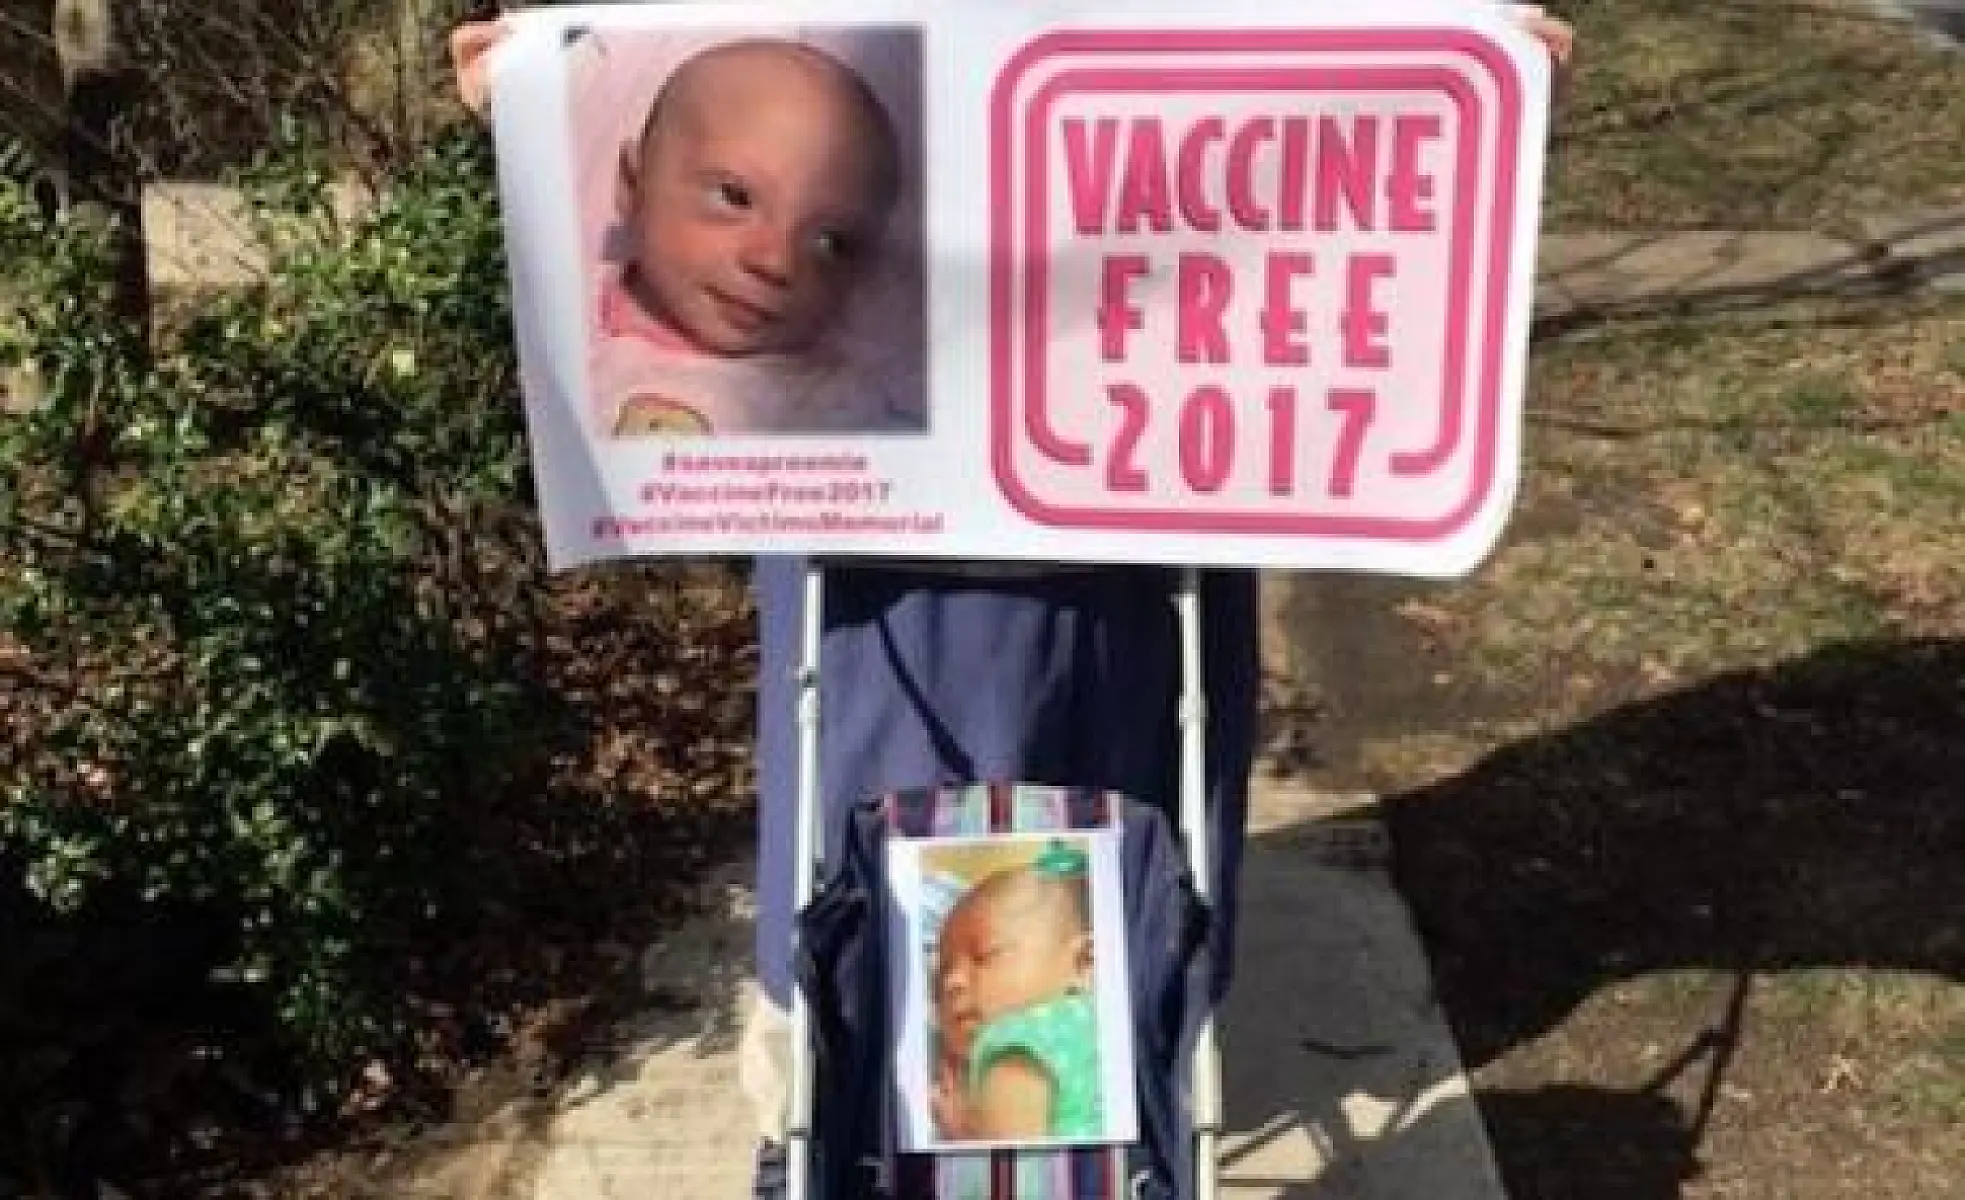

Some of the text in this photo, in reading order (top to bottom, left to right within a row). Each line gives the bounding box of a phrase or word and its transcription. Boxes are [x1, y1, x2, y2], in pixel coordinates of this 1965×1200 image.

[1062, 115, 1442, 235] VACCINE
[1097, 252, 1396, 367] FREE
[1105, 384, 1377, 496] 2017
